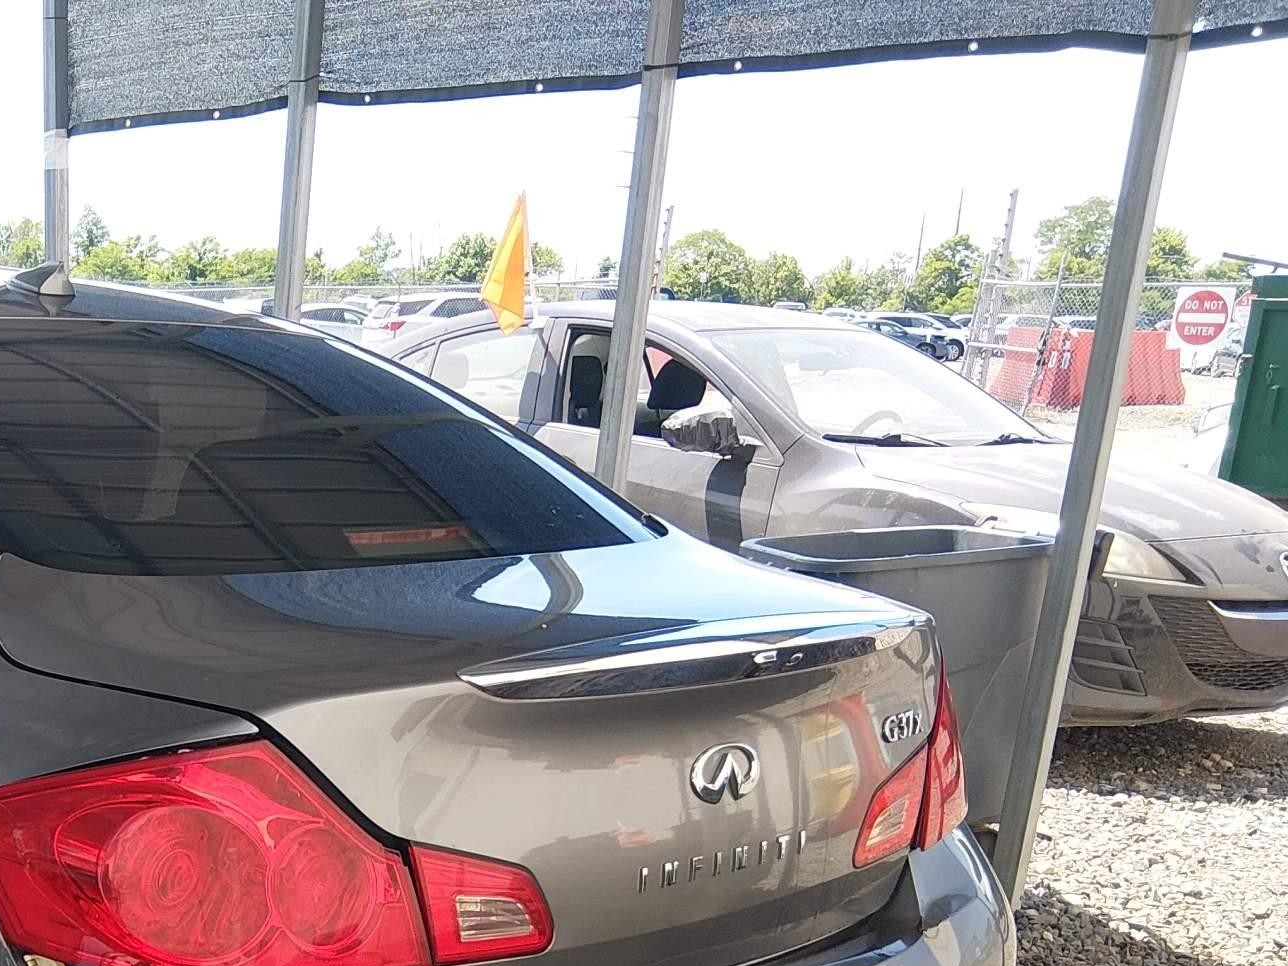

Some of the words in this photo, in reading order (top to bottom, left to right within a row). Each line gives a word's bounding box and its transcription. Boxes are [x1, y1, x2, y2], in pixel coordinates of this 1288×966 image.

[1185, 300, 1199, 310] DO
[1203, 300, 1225, 310] NOT
[1183, 326, 1215, 336] ENTER
[637, 830, 807, 895] INFINITI
